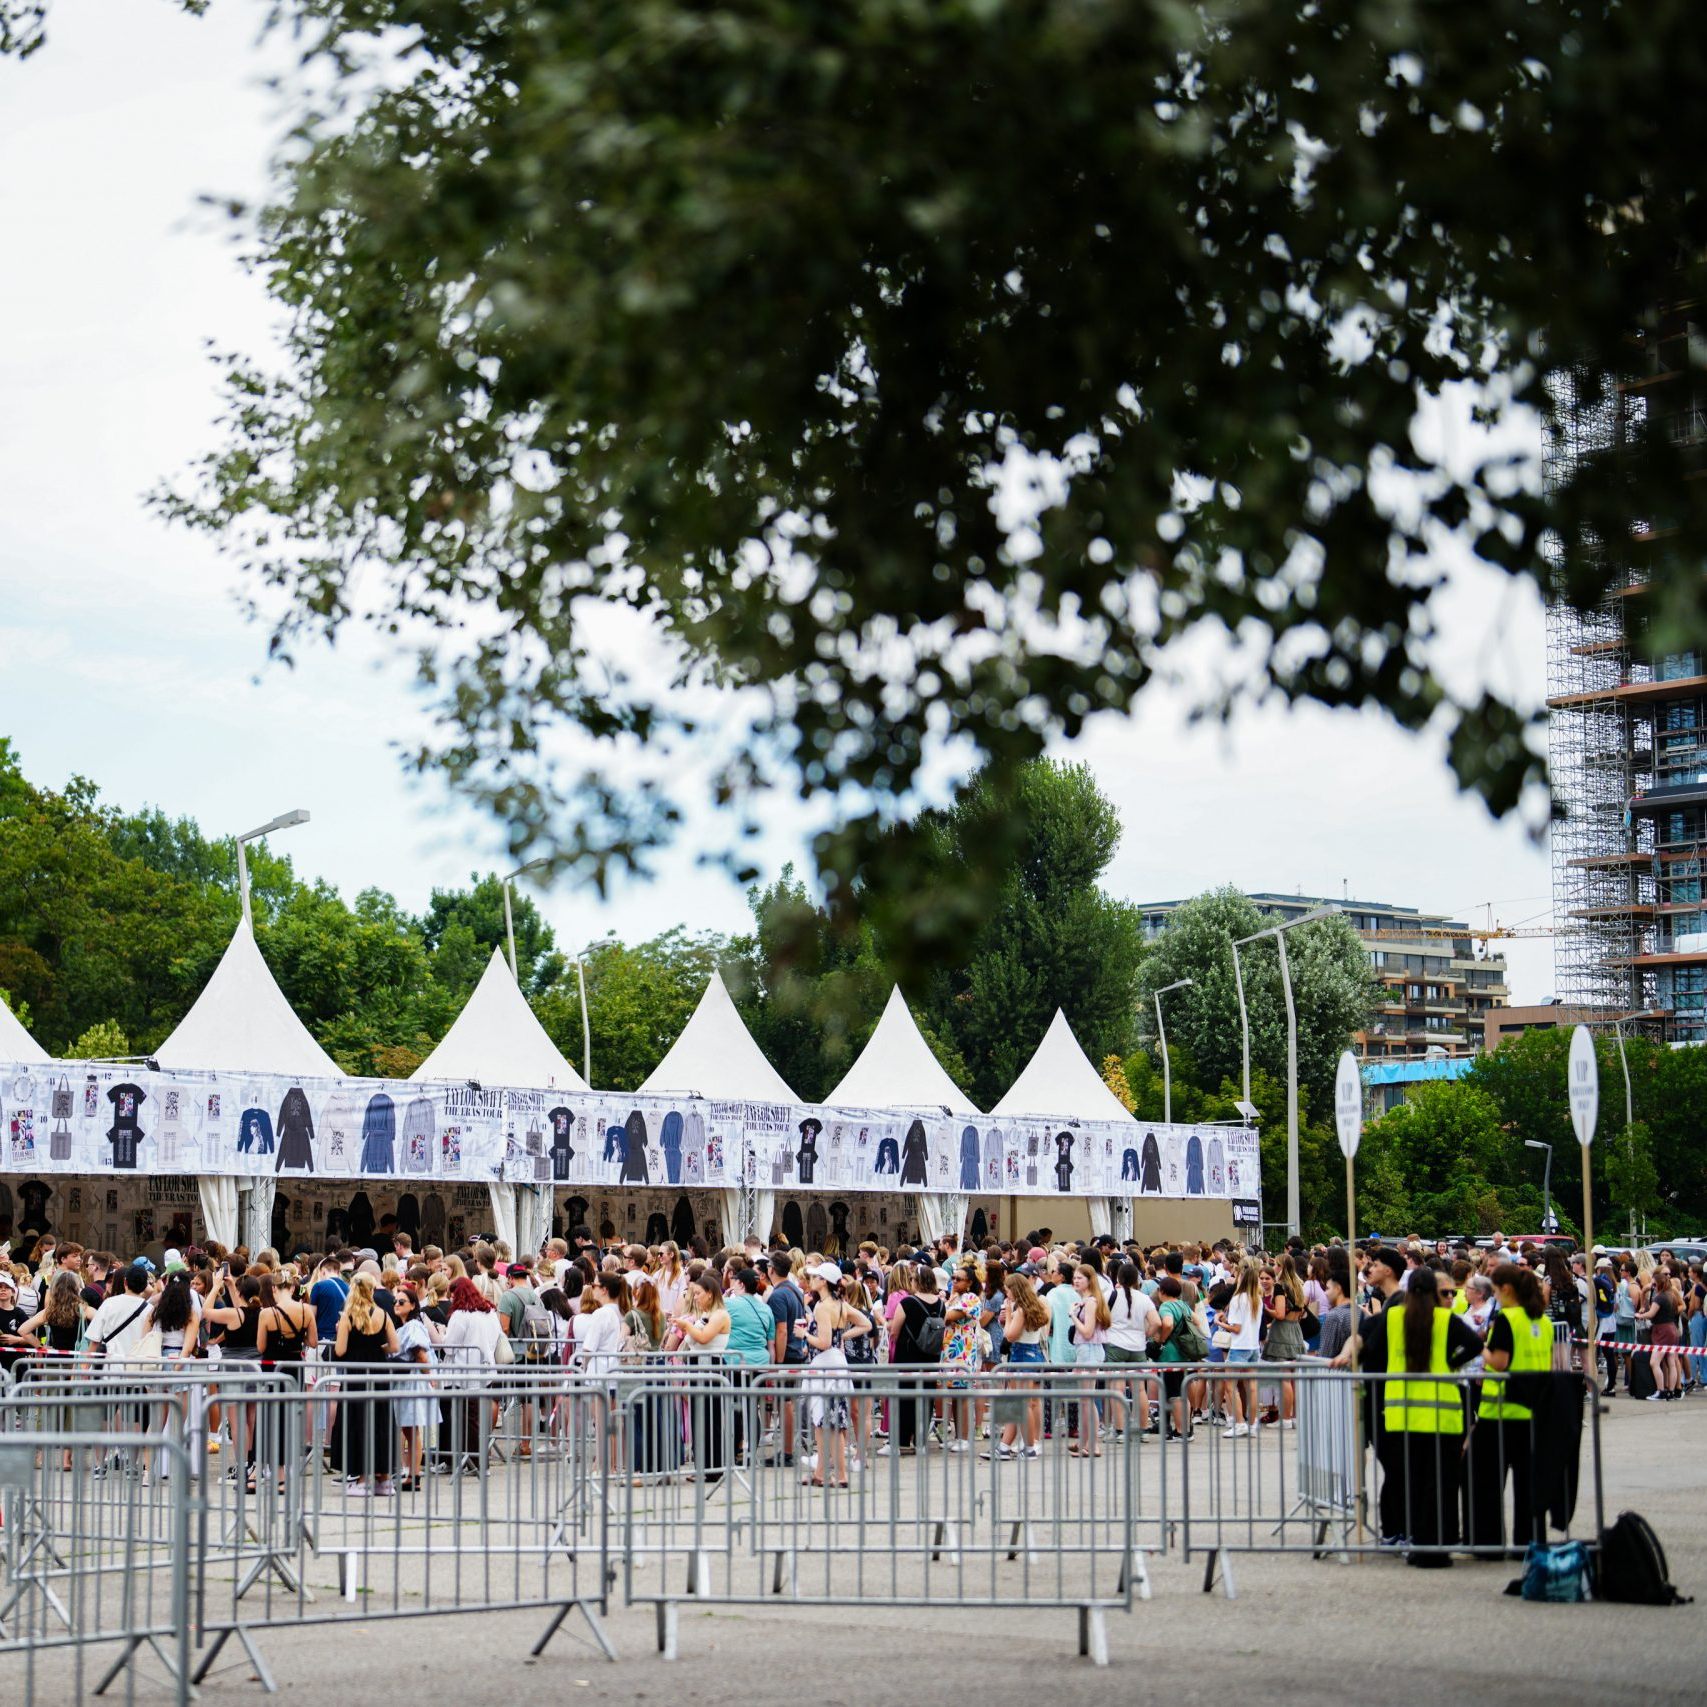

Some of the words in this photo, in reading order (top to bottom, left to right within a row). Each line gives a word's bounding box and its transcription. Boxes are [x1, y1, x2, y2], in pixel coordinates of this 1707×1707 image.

[1575, 1060, 1588, 1081] VIP
[445, 1088, 477, 1106] TAYLOR
[477, 1089, 503, 1108] SWIFT
[508, 1091, 528, 1104] TAYLOR
[528, 1093, 545, 1105] SWIFT
[444, 1106, 459, 1116] THE
[460, 1107, 480, 1117] ERAS
[482, 1108, 502, 1119] TOUR
[710, 1103, 728, 1113] TAYLOR
[729, 1104, 743, 1114] SWIFT
[745, 1104, 770, 1122] TAYLOR
[770, 1107, 791, 1123] SWIFT
[745, 1122, 758, 1131] THE
[758, 1122, 773, 1131] ERAS
[774, 1124, 789, 1132] TOUR
[104, 1157, 112, 1165] 13
[149, 1175, 180, 1191] TAYLOR
[149, 1192, 162, 1201] THE
[164, 1193, 184, 1201] ERAS
